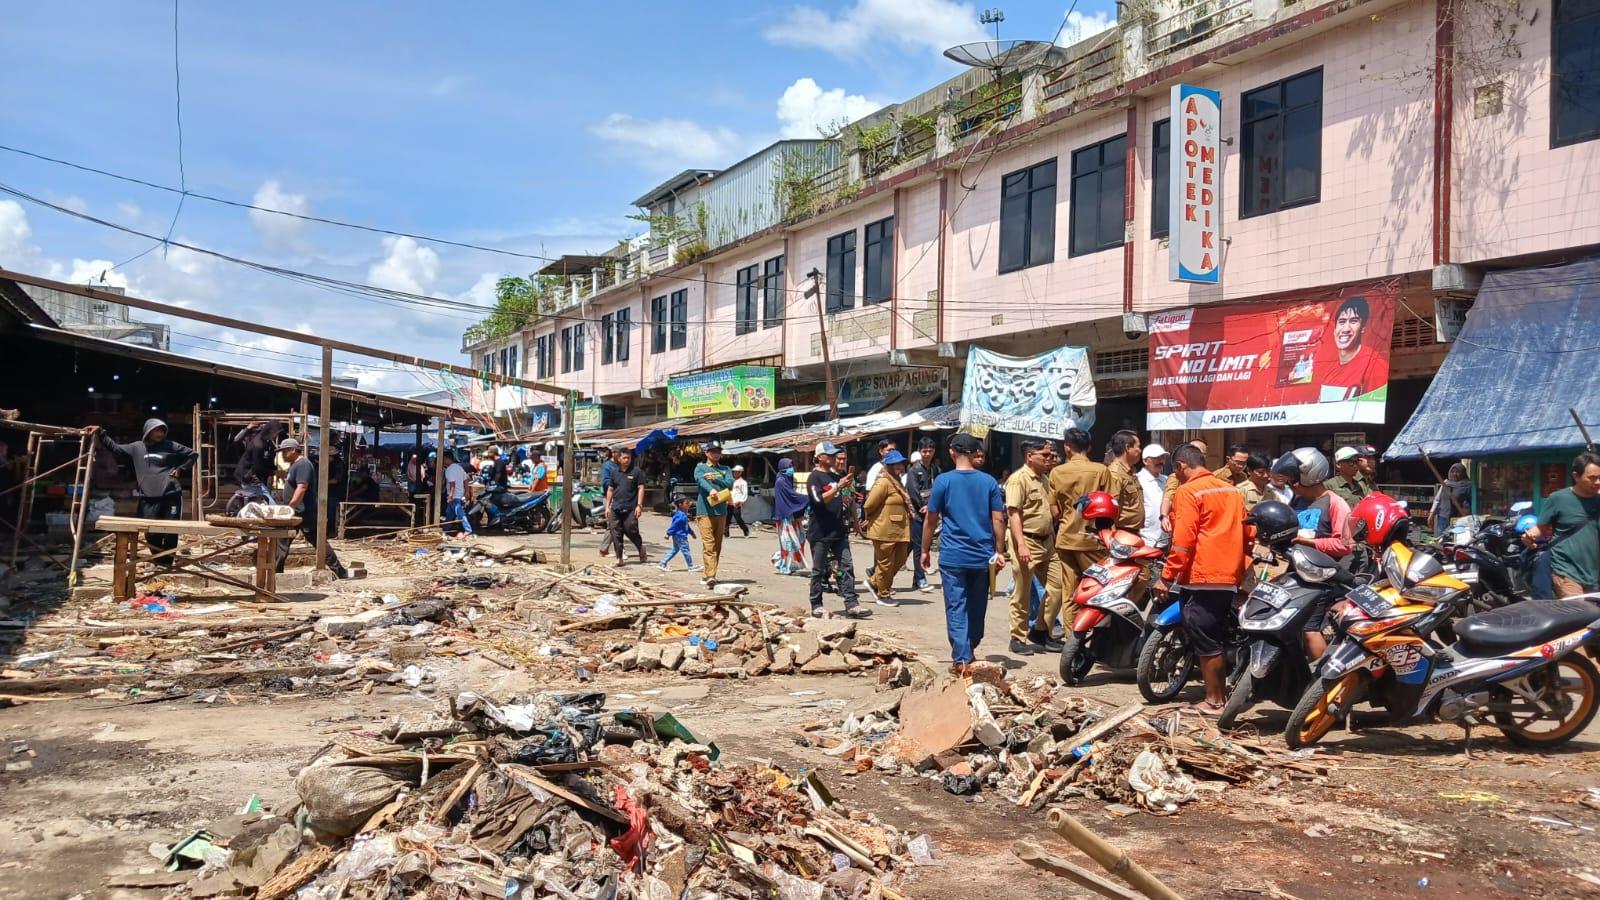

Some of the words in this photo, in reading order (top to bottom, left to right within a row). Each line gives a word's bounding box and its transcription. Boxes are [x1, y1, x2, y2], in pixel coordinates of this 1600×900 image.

[1184, 97, 1199, 222] APOTEK
[1201, 145, 1215, 271] MEDIKA
[1154, 340, 1227, 360] SPIRIT
[1178, 358, 1207, 374] NO
[1208, 354, 1258, 371] LIMIT
[873, 374, 900, 390] SINAR
[904, 369, 938, 387] AGUNG
[1216, 373, 1233, 382] DAN
[1234, 371, 1252, 380] LAGI
[1013, 420, 1037, 433] JUAL
[1039, 421, 1063, 435] BEL
[1210, 413, 1248, 424] APOTEK
[1249, 411, 1287, 422] MEDIKA
[1389, 649, 1421, 667] 93
